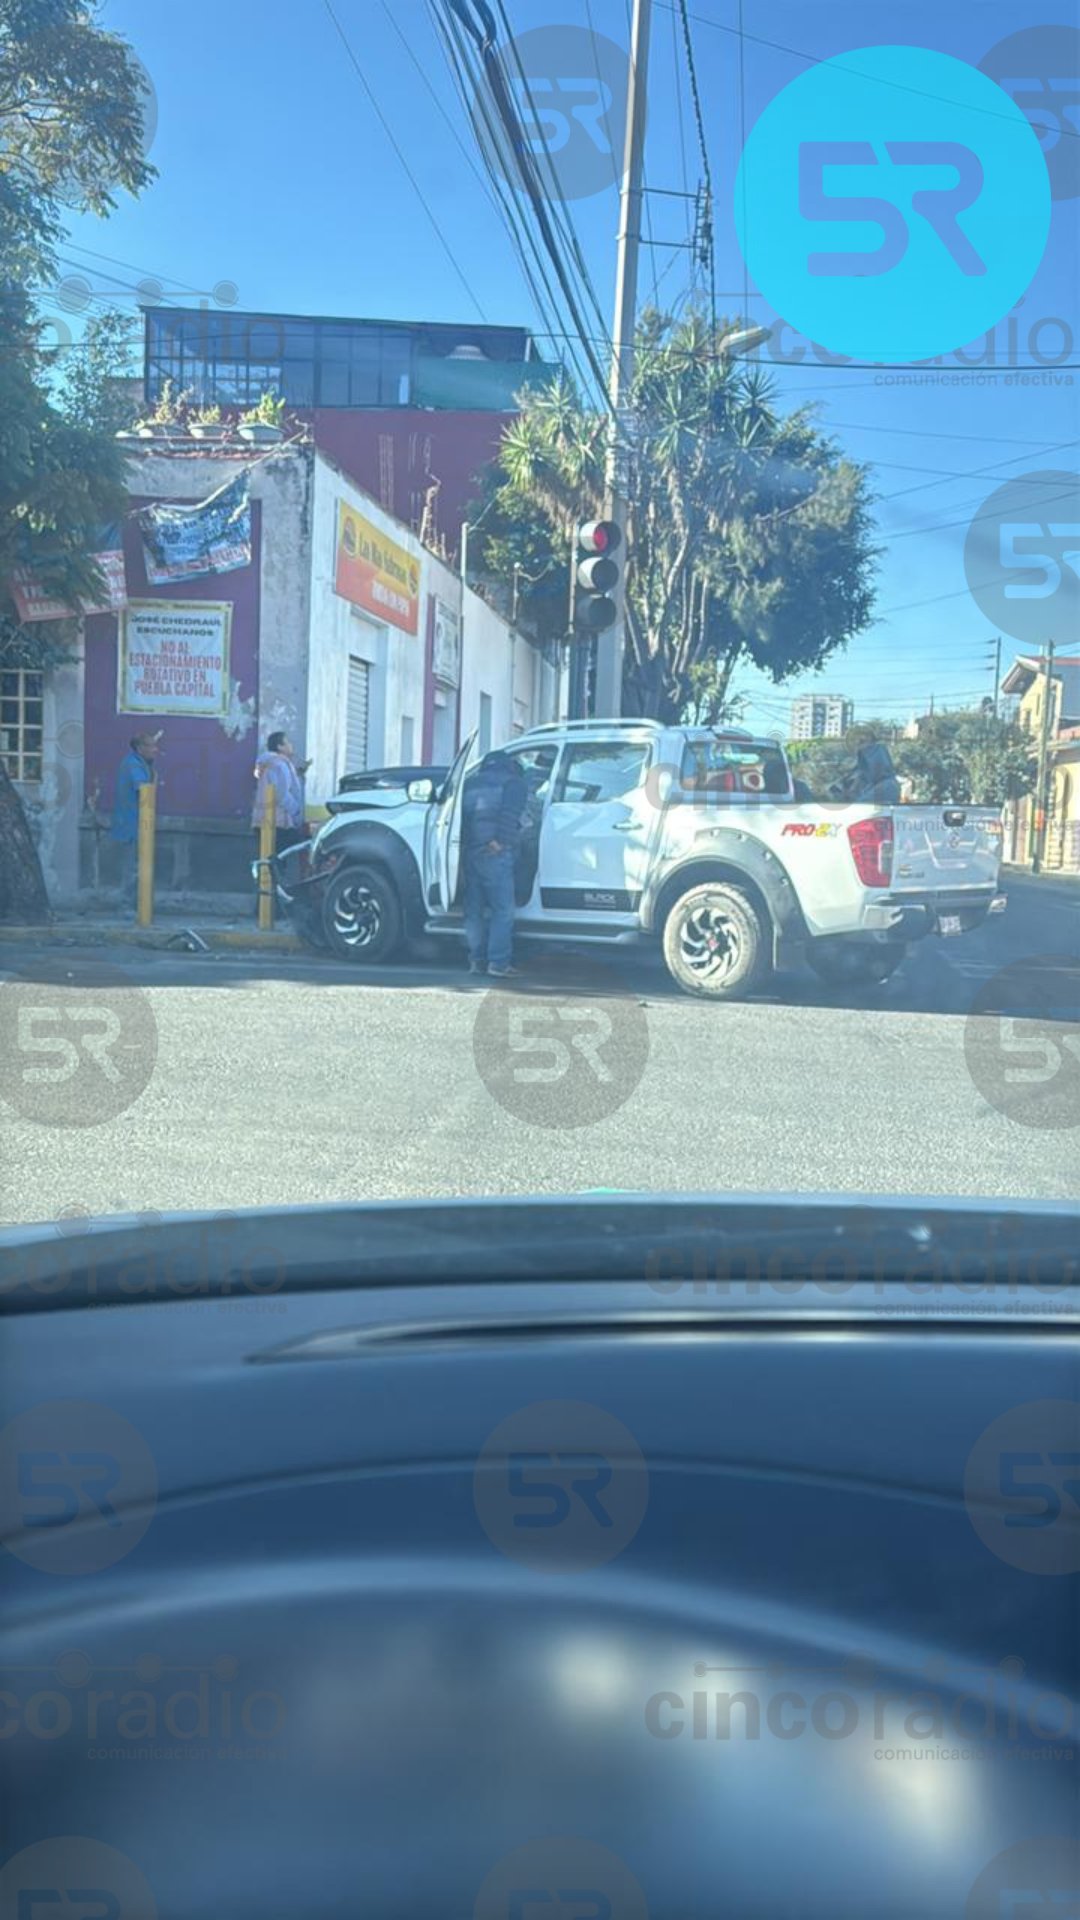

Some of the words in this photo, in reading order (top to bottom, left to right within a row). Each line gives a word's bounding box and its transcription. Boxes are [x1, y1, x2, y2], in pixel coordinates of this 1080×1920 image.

[161, 640, 177, 654] NO
[128, 653, 222, 671] ESTACIONAMIENTO
[134, 681, 172, 696] PUEBLA
[174, 682, 216, 698] CAPITAL
